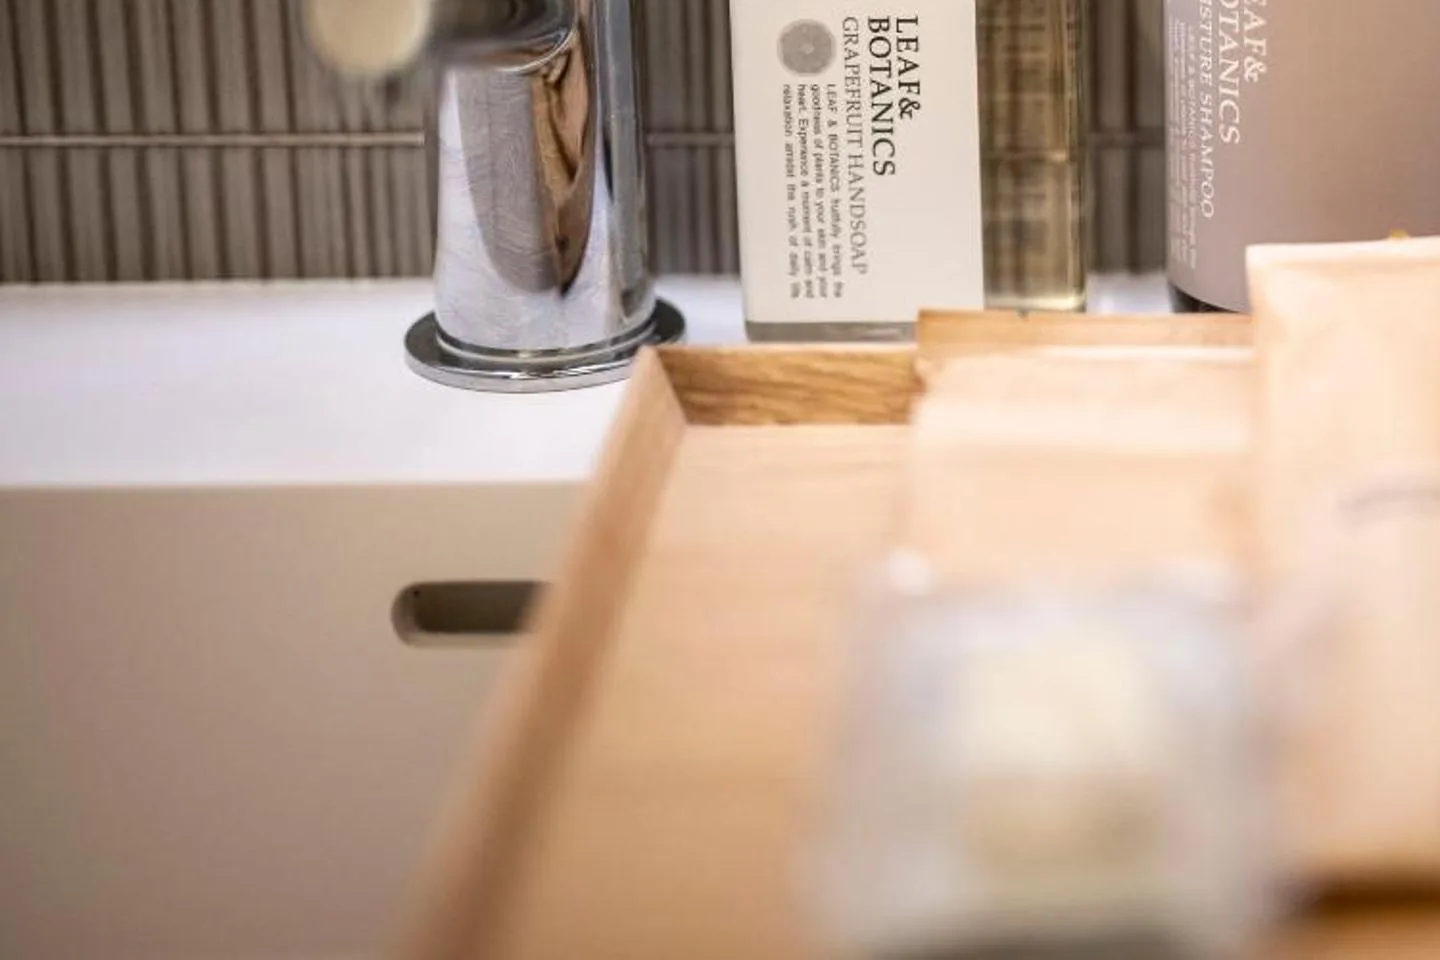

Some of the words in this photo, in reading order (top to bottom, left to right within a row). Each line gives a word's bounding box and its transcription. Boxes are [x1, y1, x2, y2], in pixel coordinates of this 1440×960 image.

[842, 17, 864, 151] GRAPEFRUIT
[896, 17, 921, 120] LEAF&
[783, 84, 794, 136] relaxation
[827, 84, 837, 113] LEAF
[868, 16, 895, 176] BOTANICS
[814, 139, 824, 149] of
[828, 120, 837, 128] &
[797, 119, 809, 176] Experience
[813, 153, 824, 183] plants
[828, 134, 840, 192] BOTANICS
[1200, 91, 1214, 219] SHAMPOO
[787, 184, 796, 201] the
[816, 188, 825, 198] to
[816, 201, 825, 223] your
[847, 154, 868, 274] HANDSOAP
[819, 254, 828, 271] and
